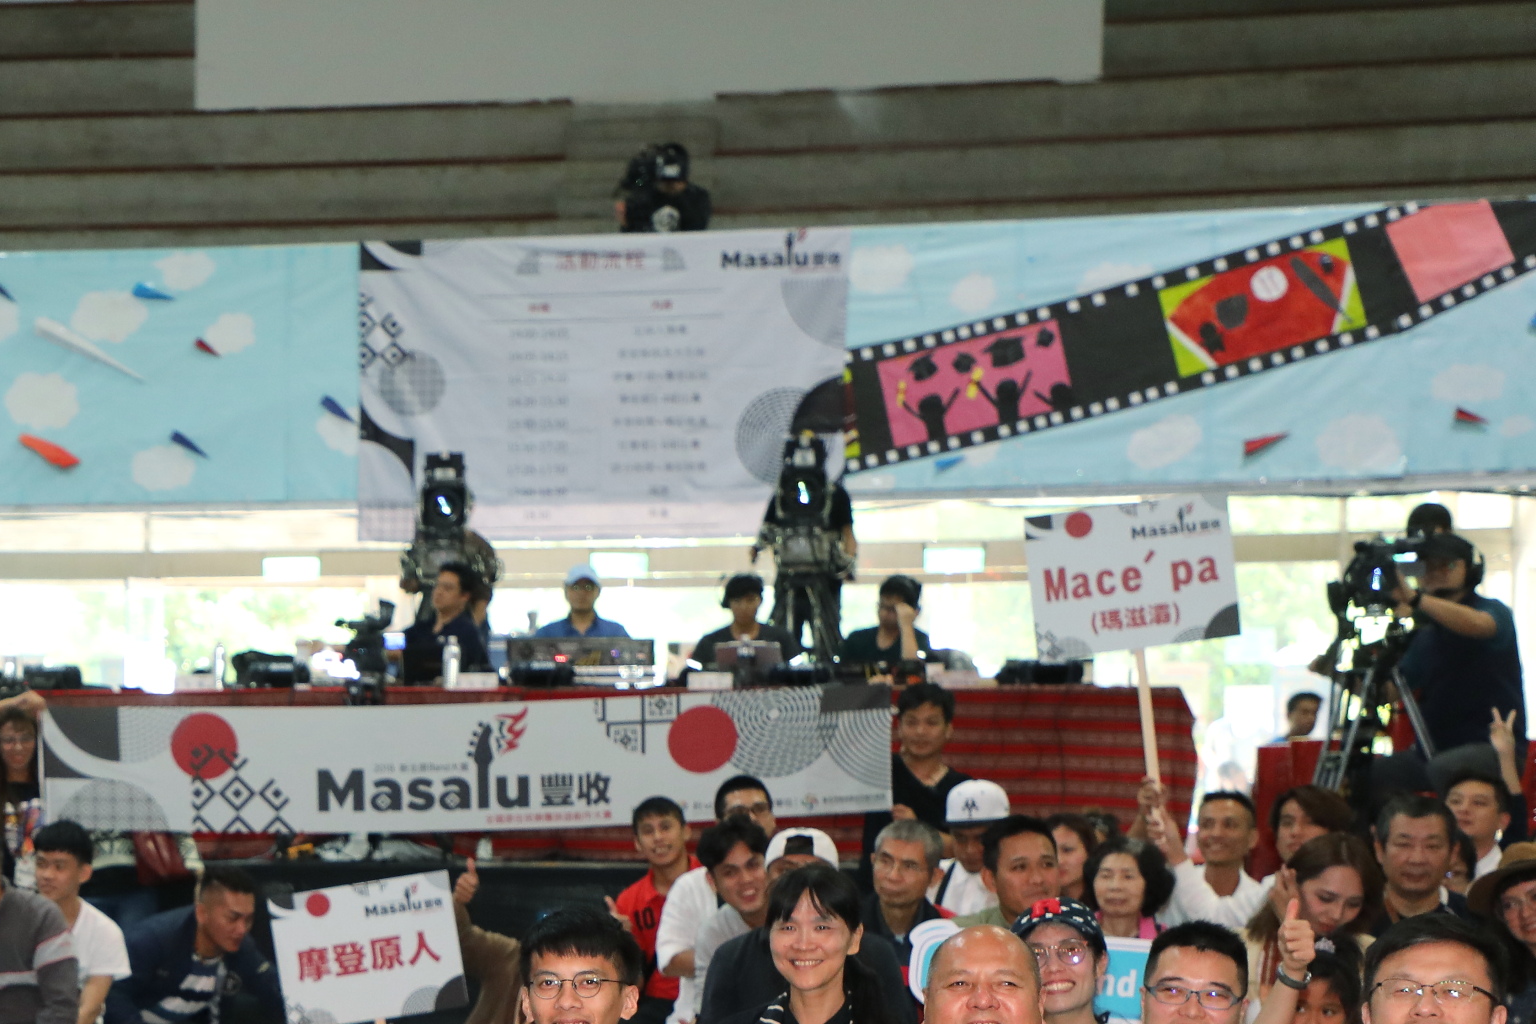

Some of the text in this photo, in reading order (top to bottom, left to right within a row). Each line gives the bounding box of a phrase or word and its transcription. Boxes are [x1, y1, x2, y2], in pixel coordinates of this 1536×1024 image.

[317, 740, 611, 812] Masalu 豐收
[297, 930, 442, 983] 摩登原人
